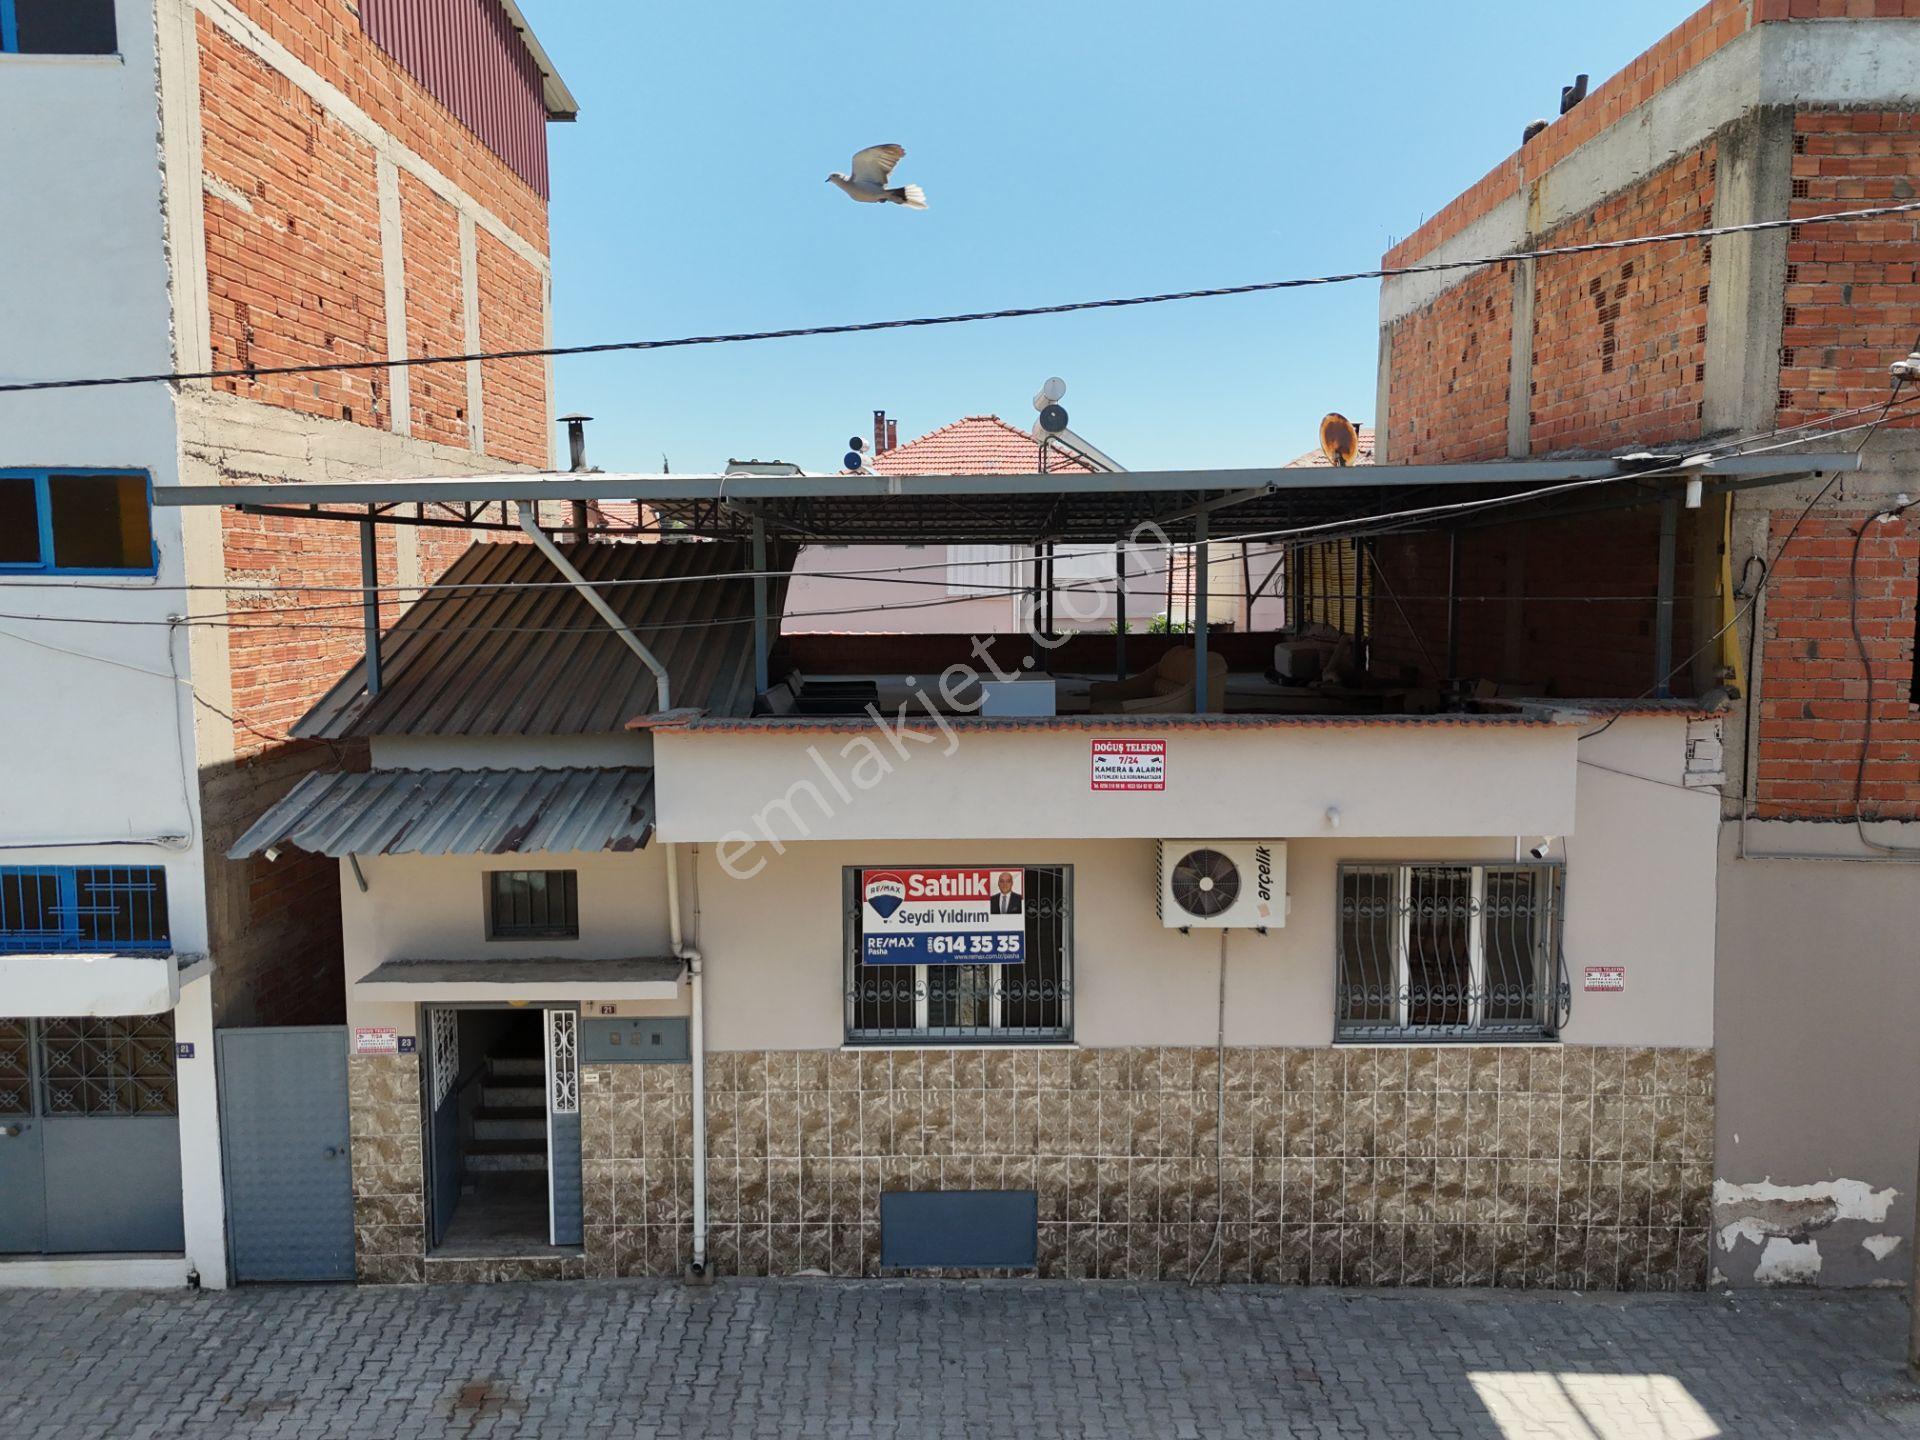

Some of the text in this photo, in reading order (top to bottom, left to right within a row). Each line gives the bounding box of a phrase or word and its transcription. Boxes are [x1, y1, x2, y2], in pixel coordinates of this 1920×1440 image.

[1094, 742, 1164, 753] DOĞUŞ TELEFON
[1118, 756, 1139, 765] 7/24
[1255, 841, 1274, 901] arçelik
[870, 885, 901, 895] RE/MAX
[908, 872, 989, 897] Satılık
[898, 909, 990, 926] Seydi Yıldırım
[867, 936, 915, 948] RE/MAX
[933, 936, 966, 953] 614
[970, 935, 993, 953] 35
[996, 935, 1020, 953] 35
[867, 948, 888, 956] Pasha
[401, 1038, 412, 1047] 23
[180, 1044, 189, 1053] 21
